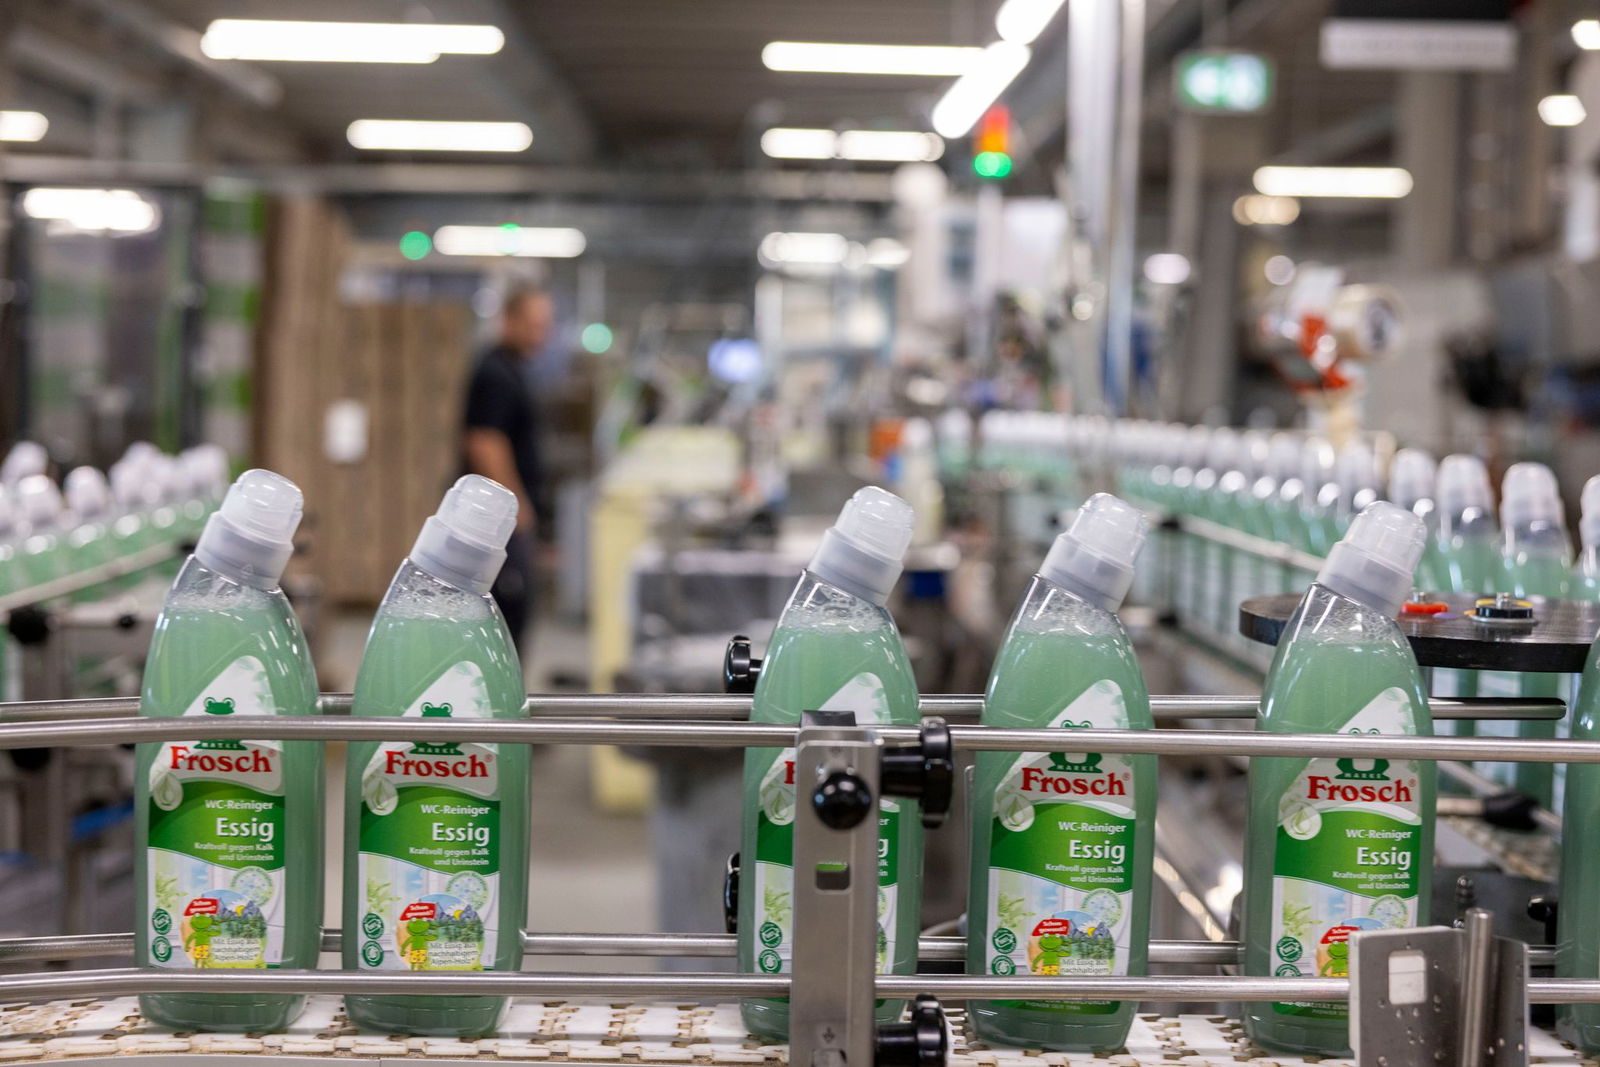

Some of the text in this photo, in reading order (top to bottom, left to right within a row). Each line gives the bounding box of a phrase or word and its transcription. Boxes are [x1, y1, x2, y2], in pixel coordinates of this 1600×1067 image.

[170, 746, 272, 772] Frosch
[384, 751, 488, 777] Frosch
[1020, 767, 1126, 795] Frosch
[1307, 775, 1412, 802] Frosch
[205, 800, 274, 812] WC-Reiniger
[421, 804, 490, 817] WC-Reiniger
[216, 817, 274, 842] Essig
[432, 822, 490, 847] Essig
[1058, 821, 1127, 835] WC-Reiniger
[1346, 828, 1412, 841] WC-Reiniger
[194, 842, 227, 850] Kraftvoll
[228, 844, 254, 852] gegen
[409, 847, 443, 855] Kraftvoll
[444, 849, 470, 857] gegen
[1069, 839, 1126, 864] Essig
[236, 853, 274, 861] Urinstein
[1357, 847, 1411, 870] Essig
[1045, 864, 1080, 872] Kraftvoll
[1080, 867, 1106, 875] gegen
[1332, 871, 1367, 879] Kraftvoll
[1367, 873, 1393, 881] gegen
